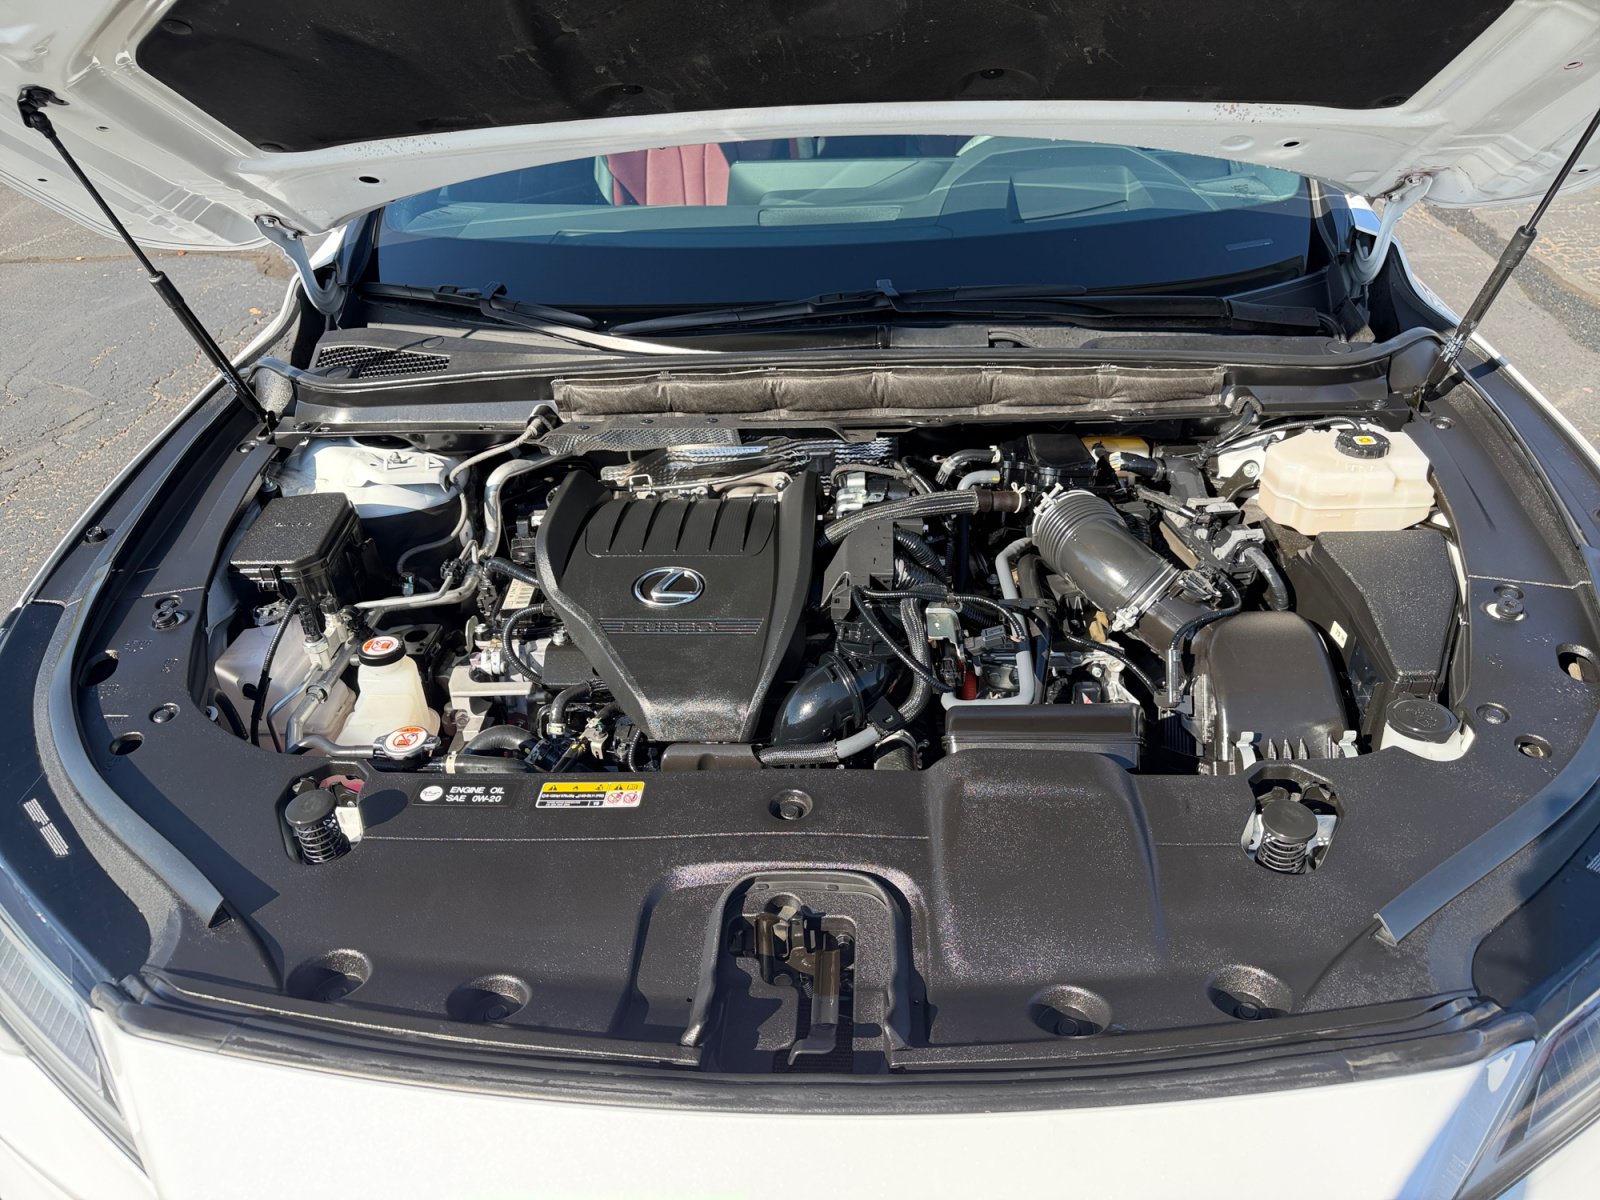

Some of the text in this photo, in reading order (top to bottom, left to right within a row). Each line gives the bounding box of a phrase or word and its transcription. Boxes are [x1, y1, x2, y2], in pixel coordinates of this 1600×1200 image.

[449, 786, 505, 794] ENGINE OIL
[445, 794, 502, 803] SAE 0W-20
